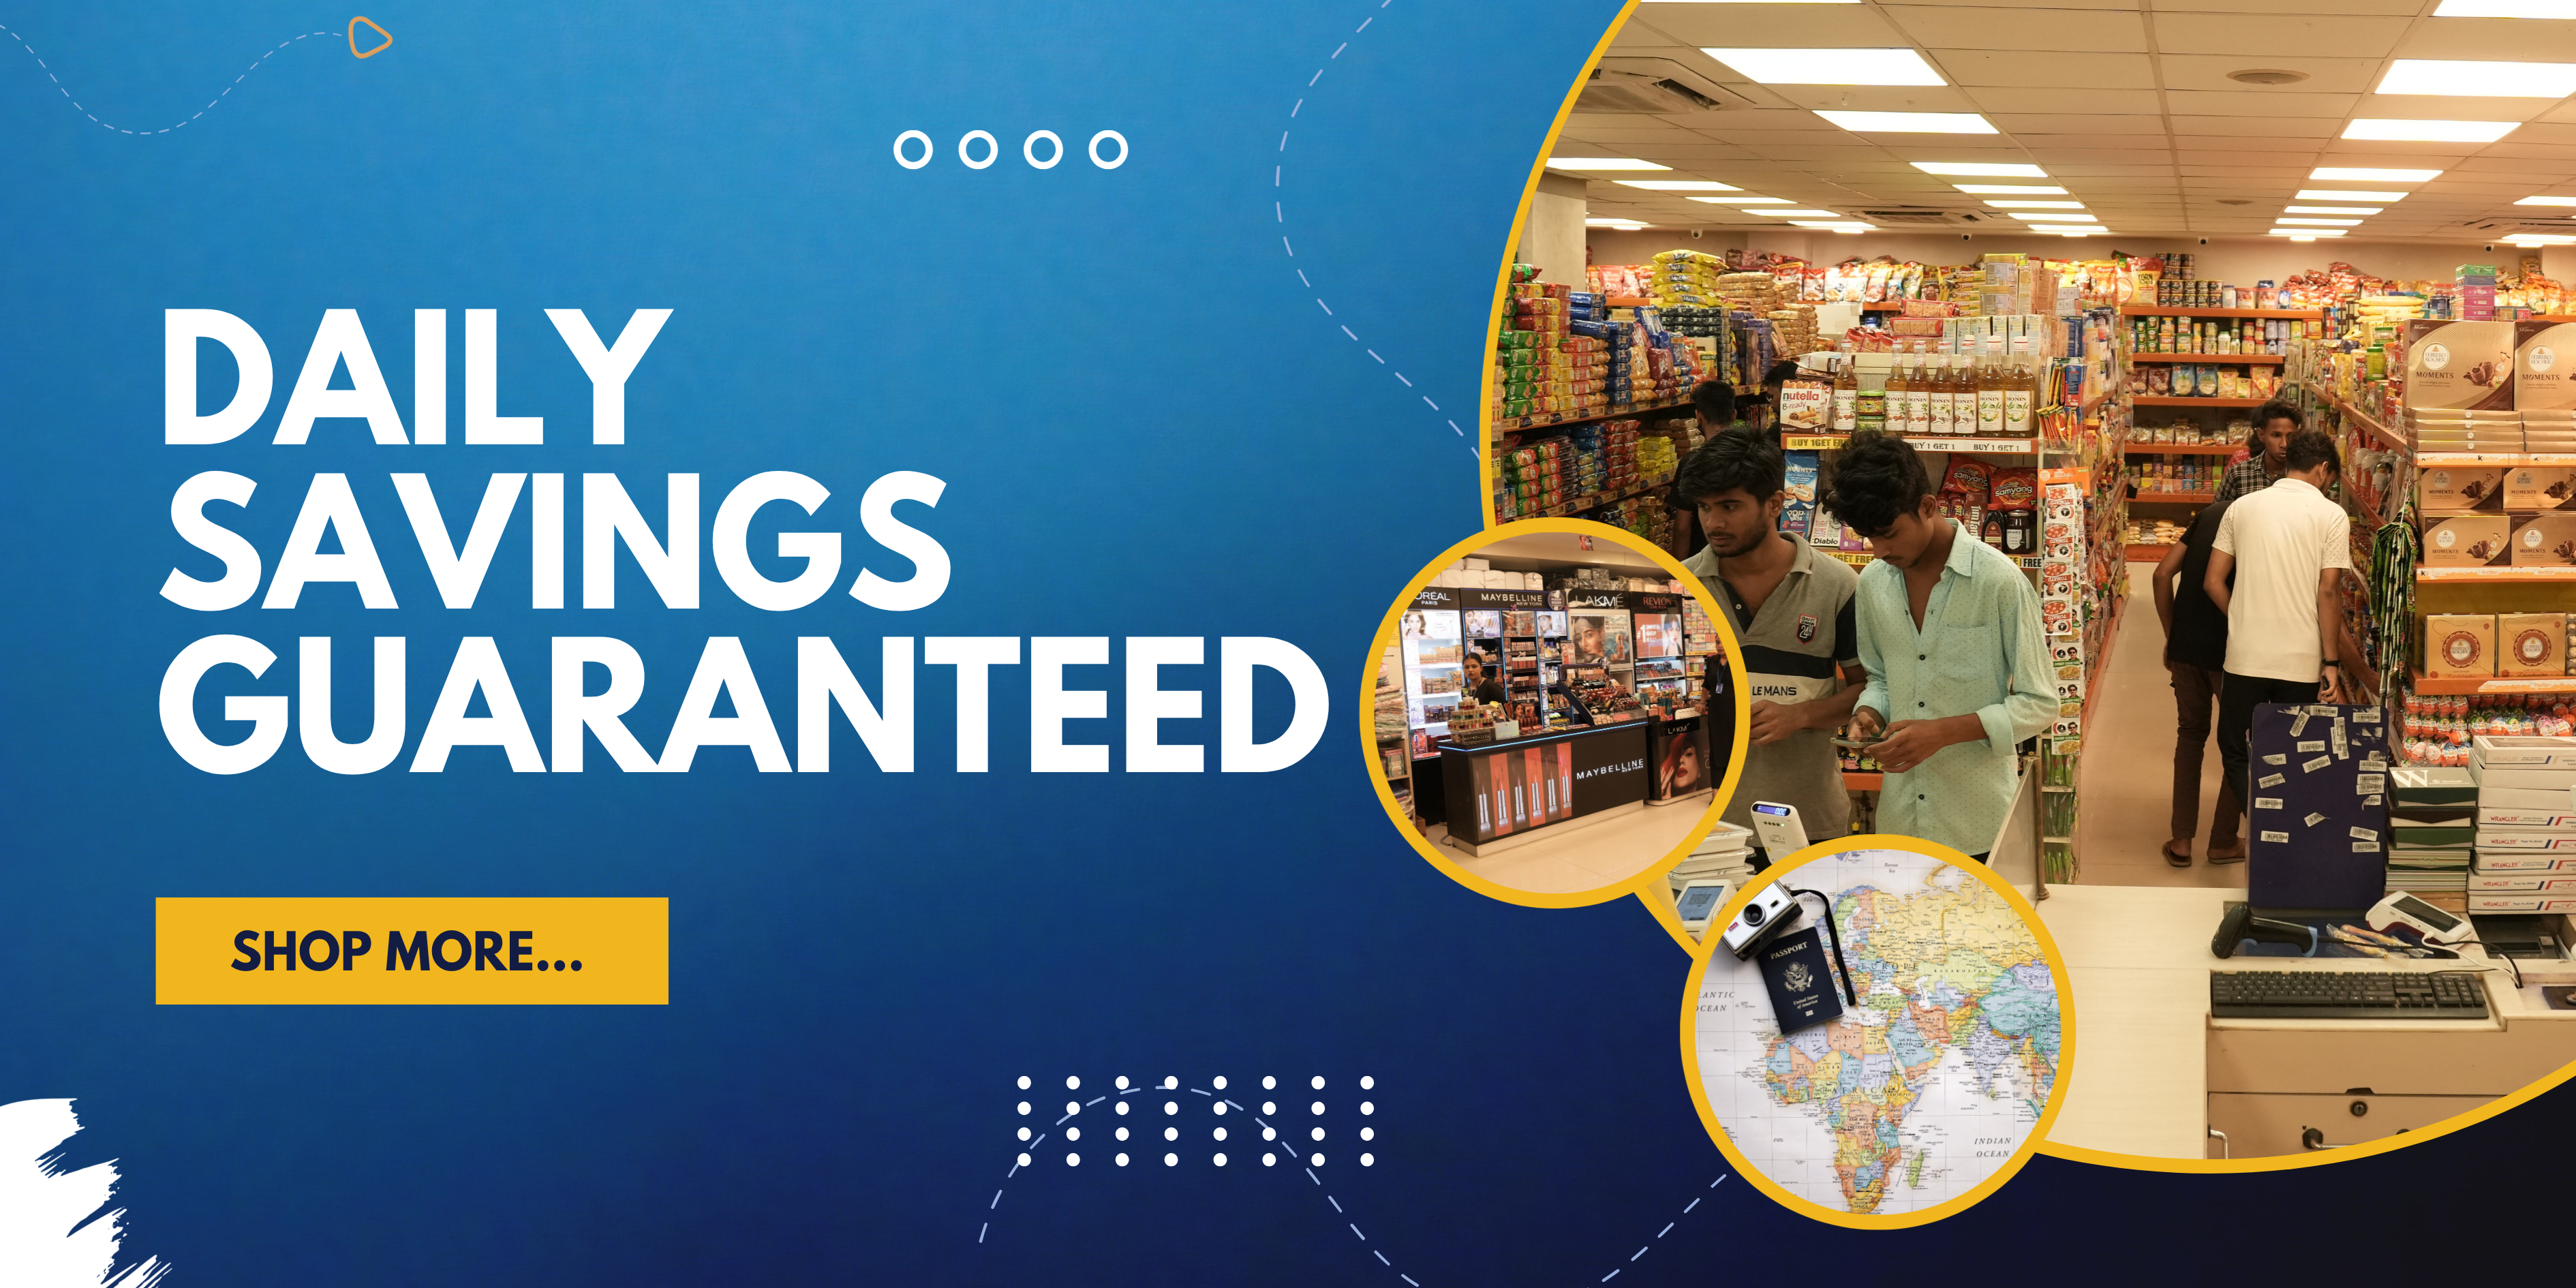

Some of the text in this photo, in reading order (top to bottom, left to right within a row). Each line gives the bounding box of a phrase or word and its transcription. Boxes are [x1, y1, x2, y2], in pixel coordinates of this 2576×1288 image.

[1783, 390, 1819, 401] nutella
[1782, 401, 1806, 410] B-ready
[1954, 472, 1988, 486] samyang
[1995, 486, 2033, 497] samyang
[1954, 505, 1963, 516] RITZ
[1856, 555, 1875, 564] FREE
[2023, 558, 2042, 567] FREE
[1482, 594, 1543, 602] MAYBELLINE
[1576, 593, 1625, 607] LAKMÉ
[1643, 597, 1672, 605] REVLON
[1800, 625, 1813, 639] 24H
[1752, 686, 1797, 696] LE MANS
[1668, 723, 1689, 734] LAKM
[1464, 731, 1490, 740] MAYBELLINE
[1576, 758, 1644, 780] MAYBELLINE
[2391, 769, 2429, 788] W
[1770, 942, 1808, 960] PASSPORT
[1861, 962, 1919, 970] EUROPE
[1802, 999, 1818, 1008] America
